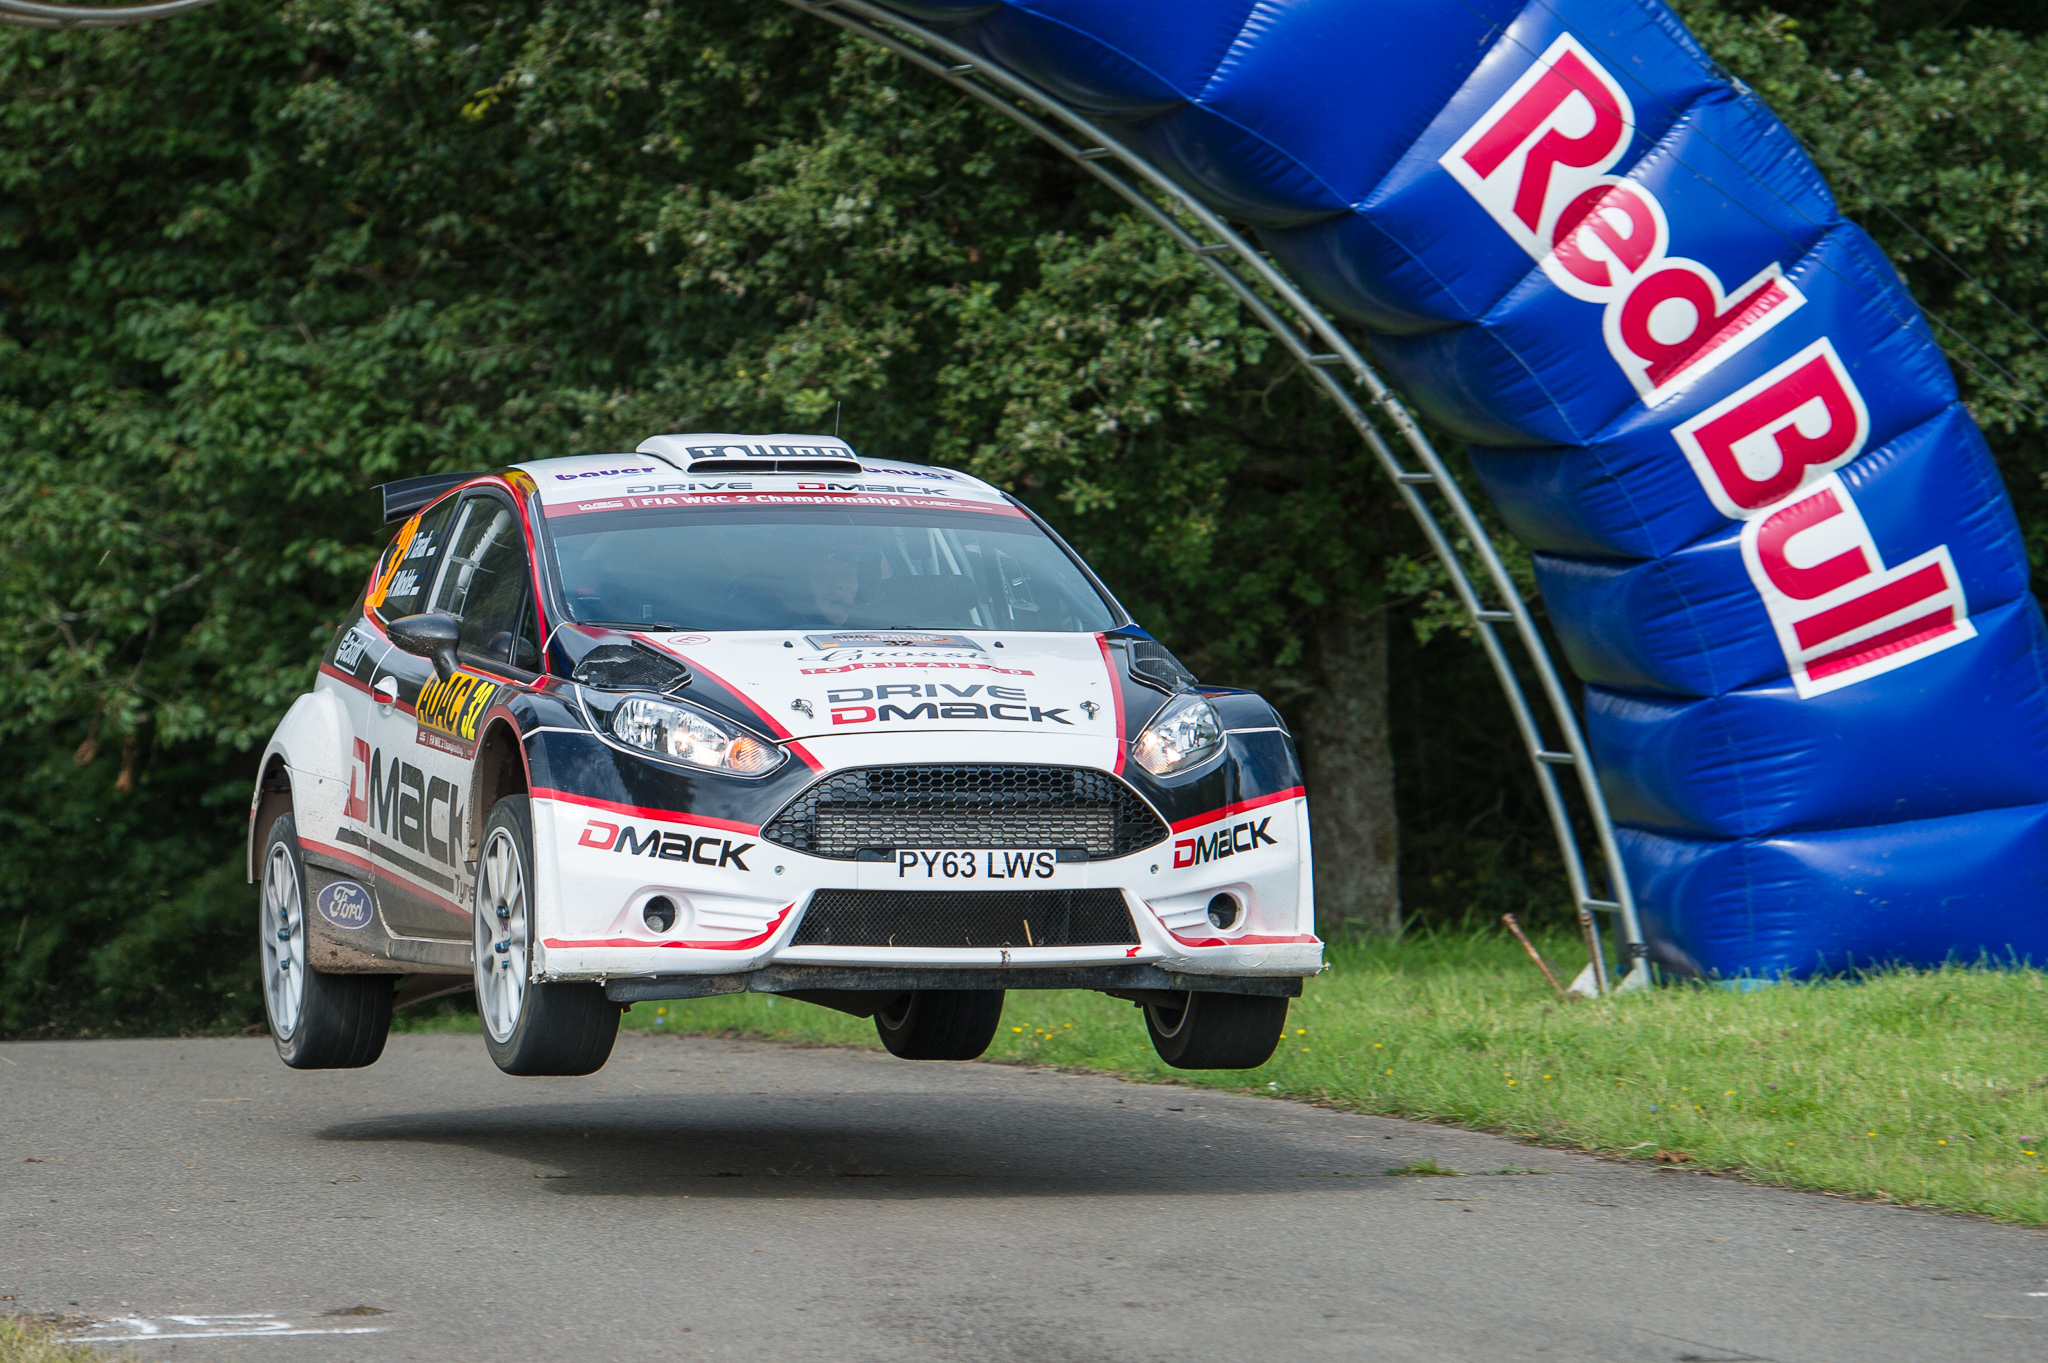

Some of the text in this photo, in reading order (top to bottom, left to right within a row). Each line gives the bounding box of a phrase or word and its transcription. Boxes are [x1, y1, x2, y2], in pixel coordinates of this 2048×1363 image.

[1460, 46, 1960, 684] Red Bull
[555, 466, 656, 480] bauer
[627, 482, 752, 493] DRIVE
[641, 498, 678, 506] FIA
[681, 496, 730, 504] WRC
[736, 495, 751, 503] 2
[754, 493, 901, 506] Championship
[827, 684, 1027, 703] DRIVE
[417, 676, 495, 741] ADAC 32
[899, 851, 1055, 879] PY63 LWS
[454, 873, 475, 903] Tyre
[329, 885, 364, 921] Ford
